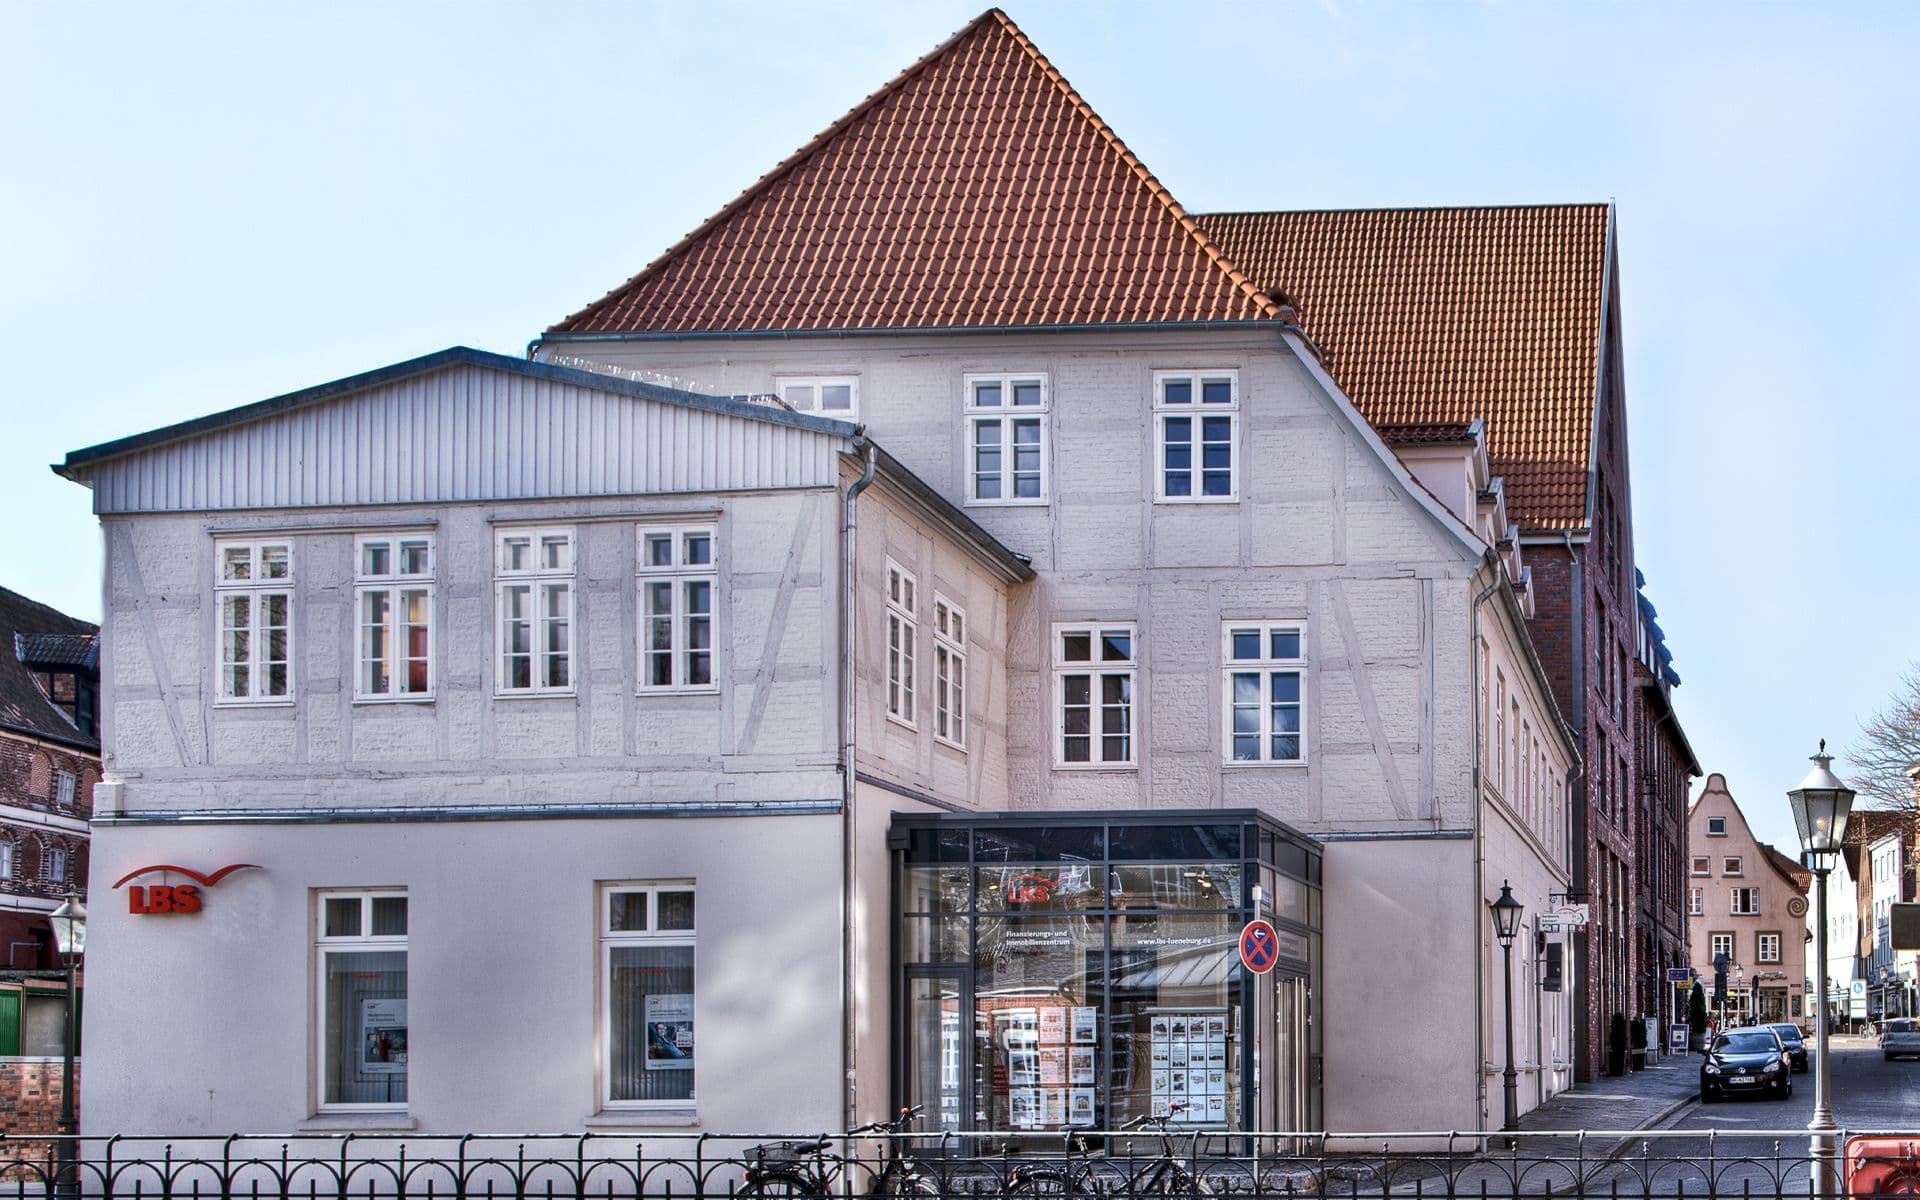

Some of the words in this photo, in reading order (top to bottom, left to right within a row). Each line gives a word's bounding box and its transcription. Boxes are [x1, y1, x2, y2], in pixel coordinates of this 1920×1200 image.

[129, 885, 202, 914] LBS
[1006, 930, 1053, 938] Finanzierungs-
[1137, 937, 1211, 945] www.lbs-lueneburg.de
